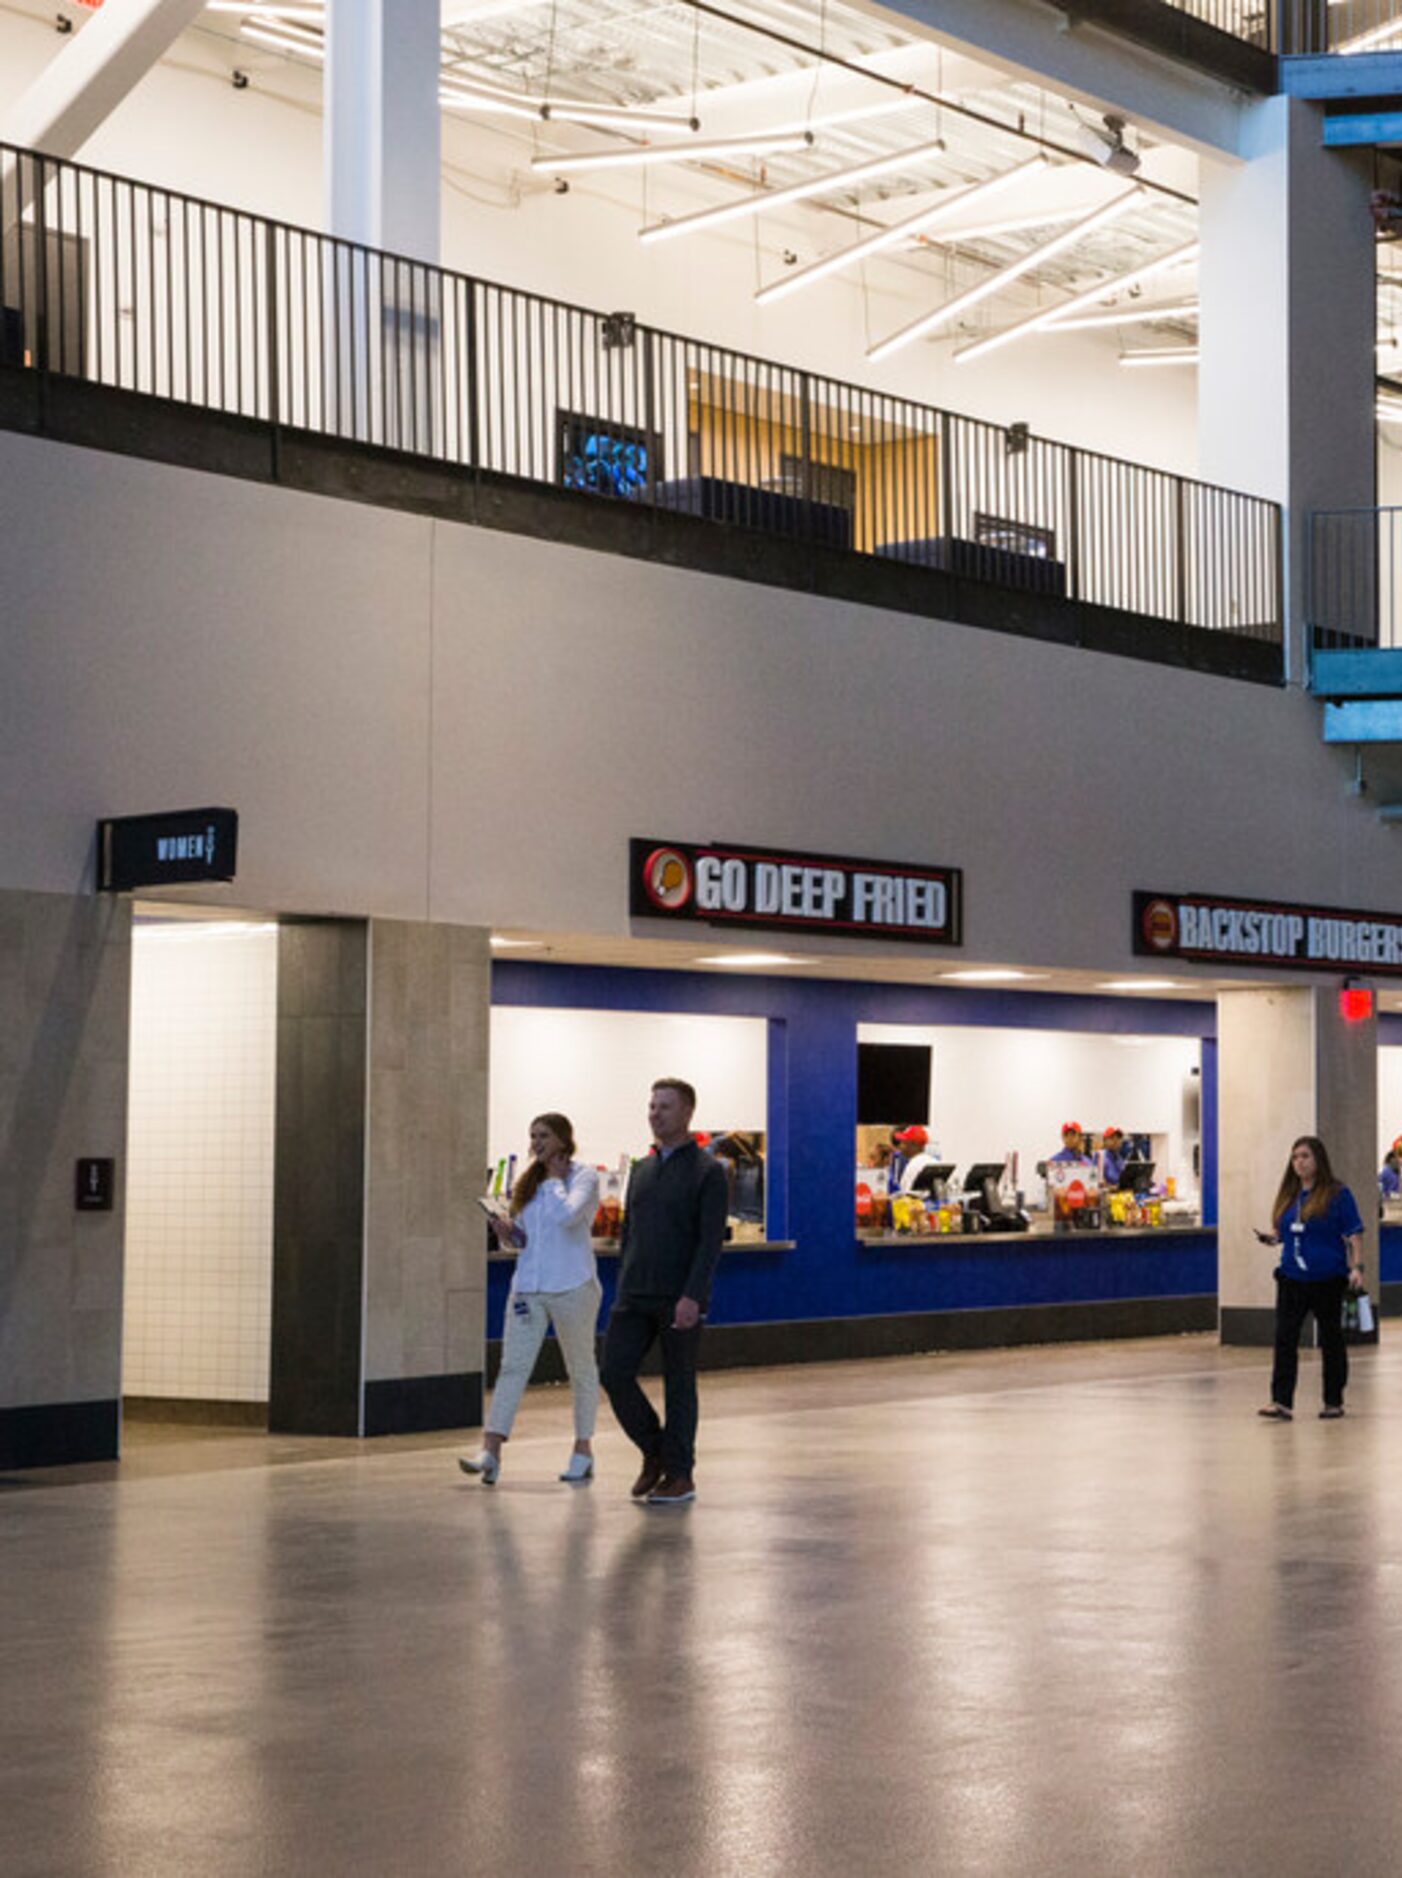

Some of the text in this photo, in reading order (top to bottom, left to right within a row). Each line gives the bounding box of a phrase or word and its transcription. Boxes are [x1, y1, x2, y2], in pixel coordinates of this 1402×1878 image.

[157, 835, 204, 861] WOMEN
[695, 856, 946, 929] GO DEEP FRIED
[1178, 904, 1303, 957] BACKSTOP
